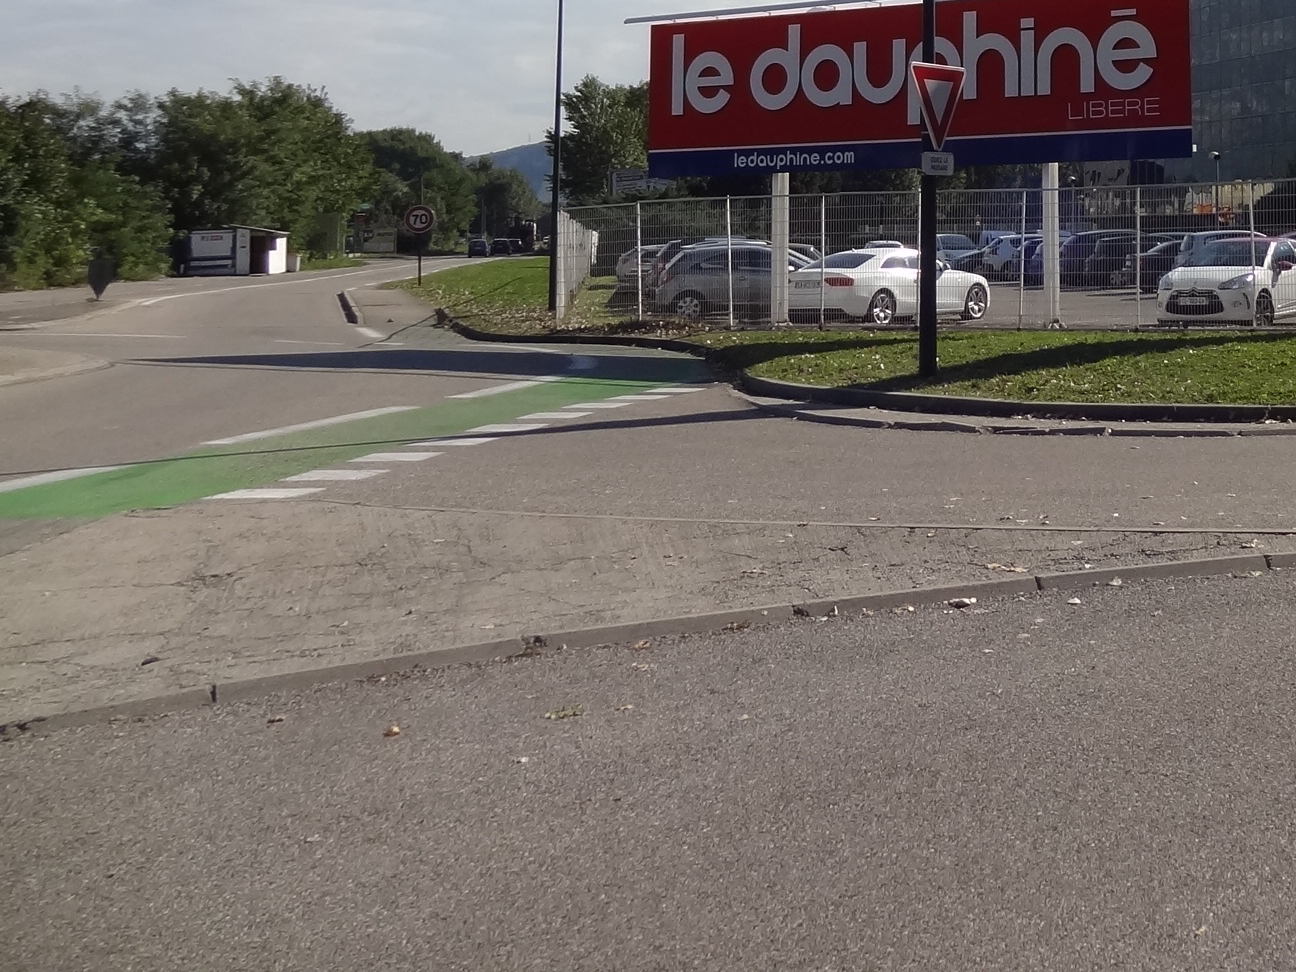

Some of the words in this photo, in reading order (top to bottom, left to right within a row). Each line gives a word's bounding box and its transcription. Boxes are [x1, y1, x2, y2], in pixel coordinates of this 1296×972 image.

[671, 33, 735, 116] le
[1068, 97, 1160, 120] LIBERE
[734, 150, 855, 170] ledauphine.com
[411, 214, 429, 226] 70
